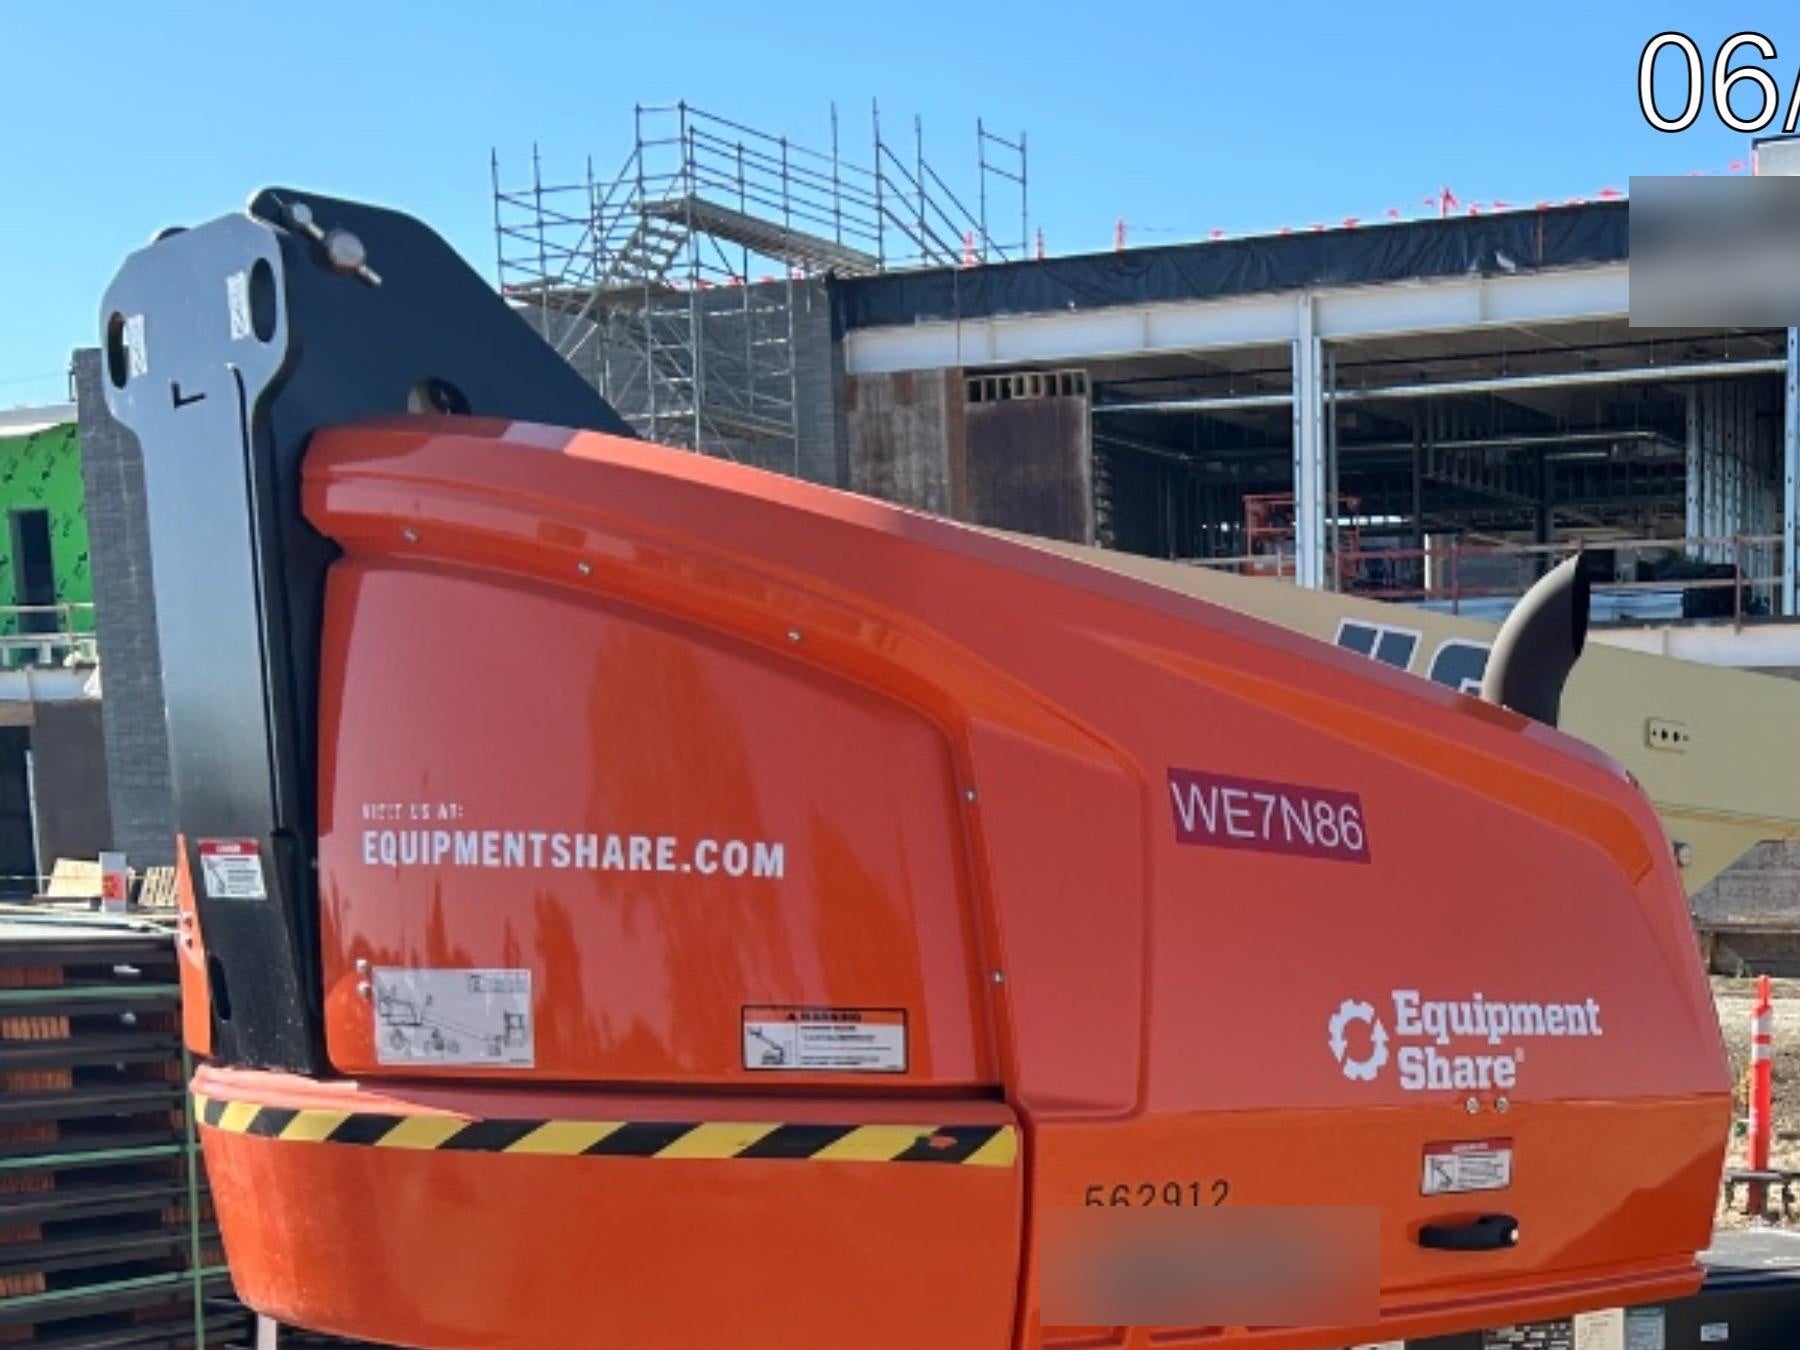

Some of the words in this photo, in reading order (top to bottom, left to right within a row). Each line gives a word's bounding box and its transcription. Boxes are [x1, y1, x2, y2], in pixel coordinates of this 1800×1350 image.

[1170, 781, 1363, 850] WE7N86
[362, 829, 785, 878] EQUIPMENTSHARE.COM
[1392, 989, 1603, 1045] Equipment
[1398, 1046, 1517, 1090] Share
